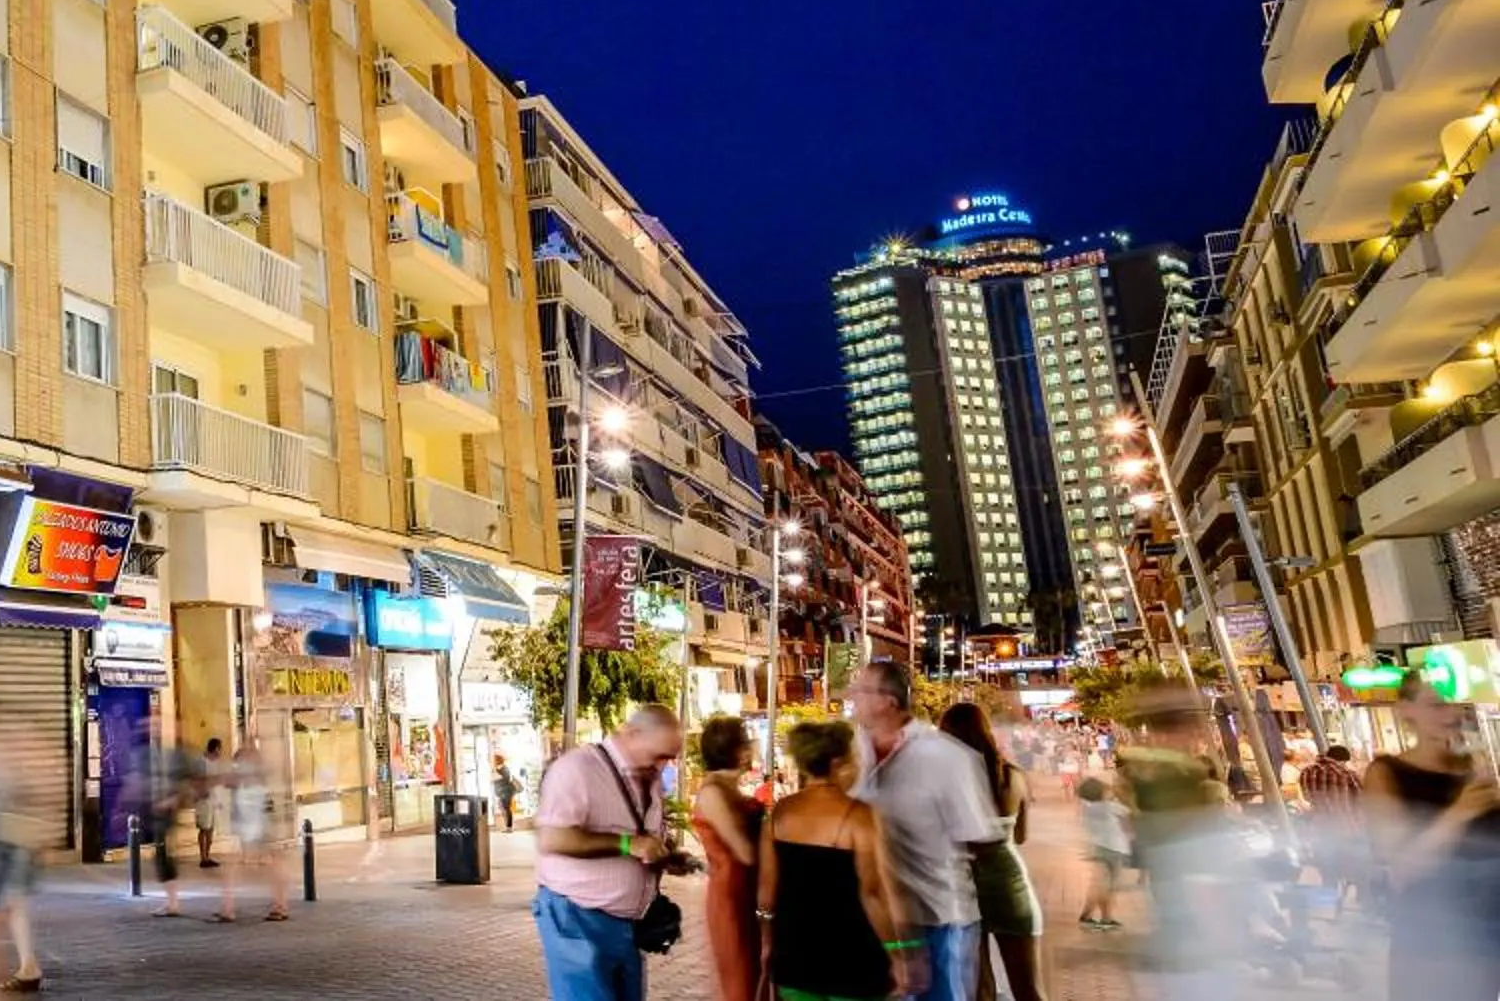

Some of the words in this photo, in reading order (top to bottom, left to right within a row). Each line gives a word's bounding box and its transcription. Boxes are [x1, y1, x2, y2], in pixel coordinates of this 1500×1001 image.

[972, 194, 1009, 207] HOTEL
[941, 211, 996, 234] Madeira
[615, 545, 638, 652] artesfera
